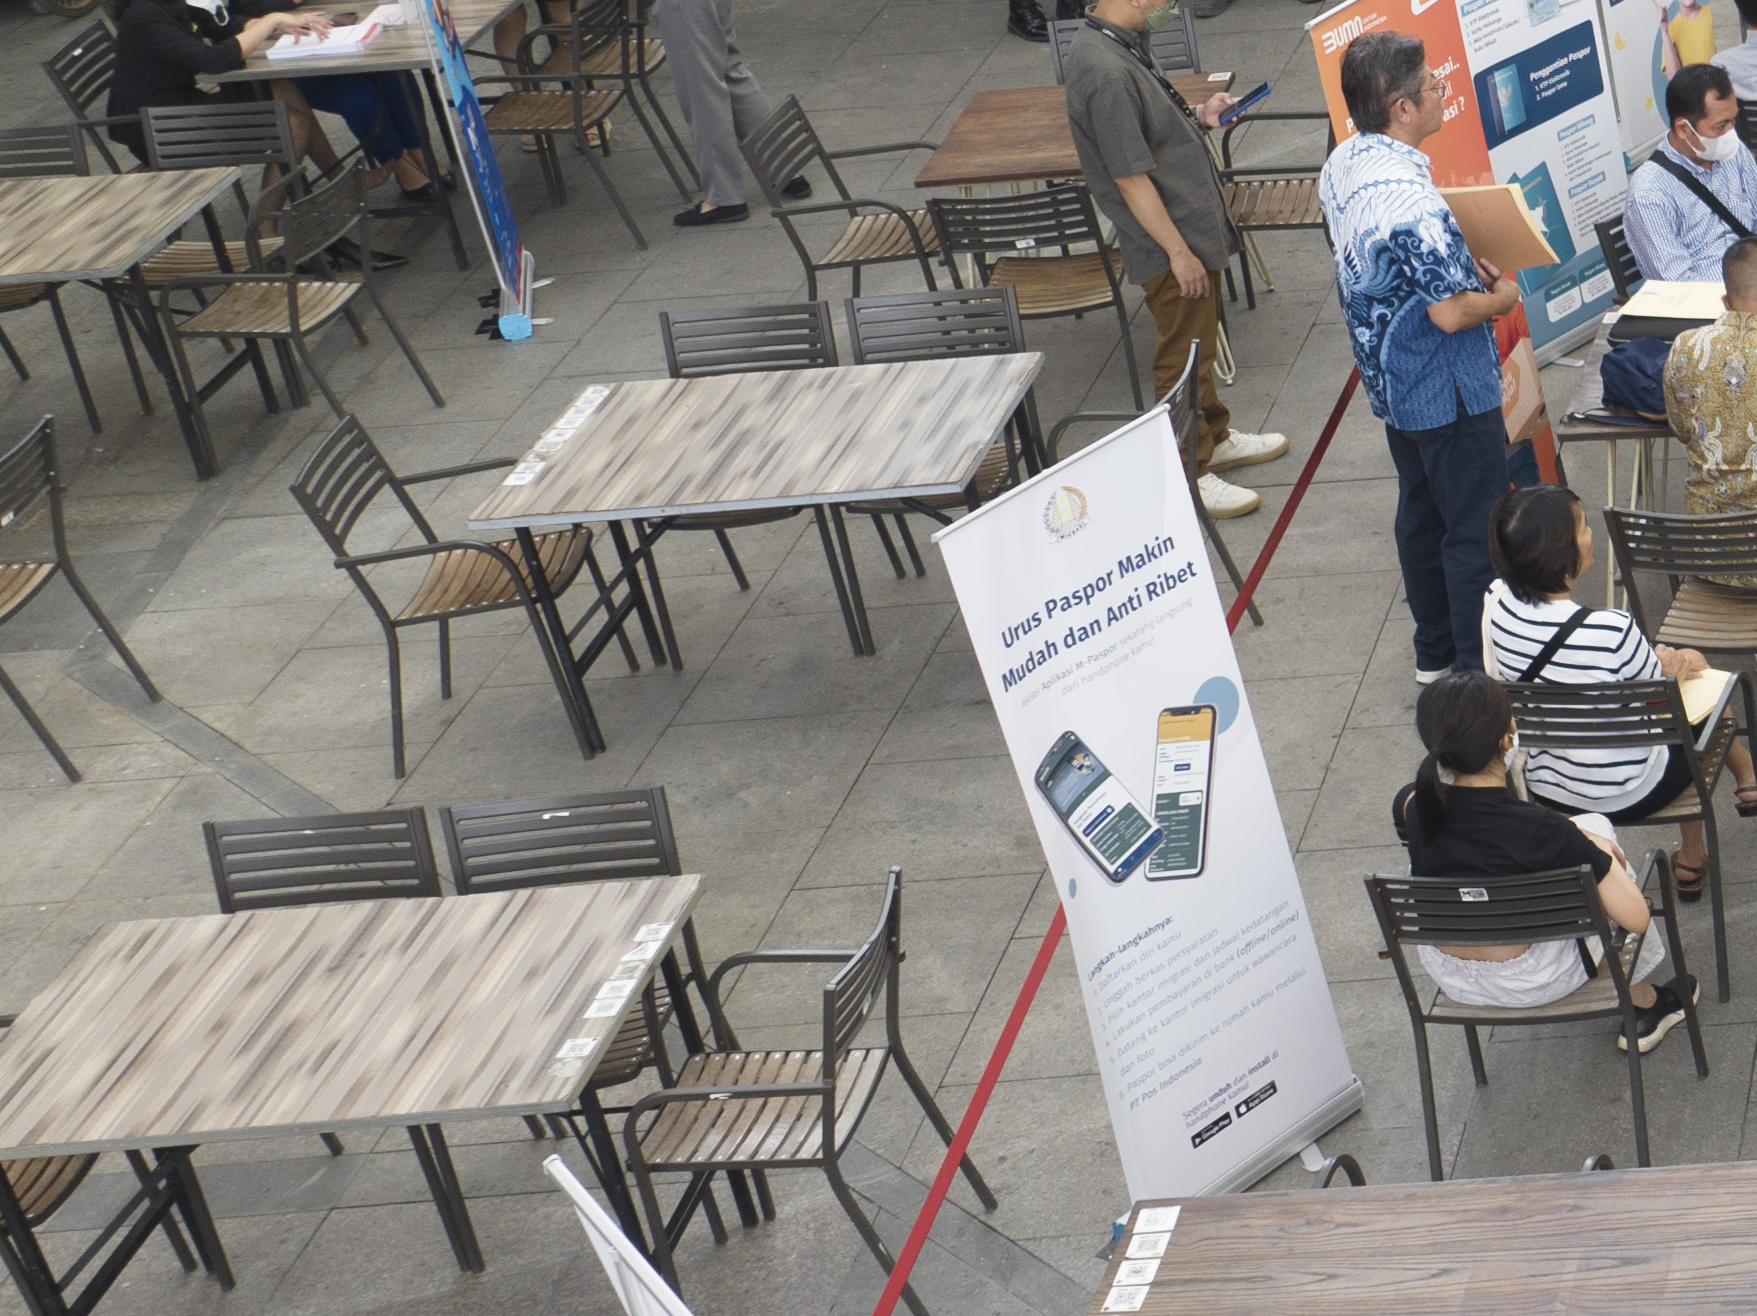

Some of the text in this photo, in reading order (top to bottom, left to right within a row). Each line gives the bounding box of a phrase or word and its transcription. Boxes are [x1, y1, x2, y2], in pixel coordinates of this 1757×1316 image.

[1530, 46, 1590, 81] Penggantian Paspor
[1002, 537, 1174, 648] Urus Paspor Makin
[1002, 562, 1196, 692] Mudah dan Anti Ribet
[1042, 598, 1192, 691] Aplikasi M-Paspor sekarang langsung
[1081, 636, 1154, 684] handphone kamu!
[1126, 901, 1289, 1009] kantor imigrasi dan jadwal kedatangan
[1135, 929, 1218, 985] berkas persyaratan
[1156, 932, 1181, 950] kamu
[1148, 976, 1202, 1016] pembayaran
[1214, 954, 1235, 972] bank
[1160, 934, 1297, 1027] kantor imigrasi untuk wawancara
[1126, 966, 1306, 1092] Paspor bisa dikirim ke rumah kamu melalui
[1120, 1048, 1155, 1077] dan foto
[1130, 1058, 1202, 1111] PT Pos Indonesia
[1182, 1055, 1270, 1120] Segera install
[1247, 1094, 1260, 1109] App
